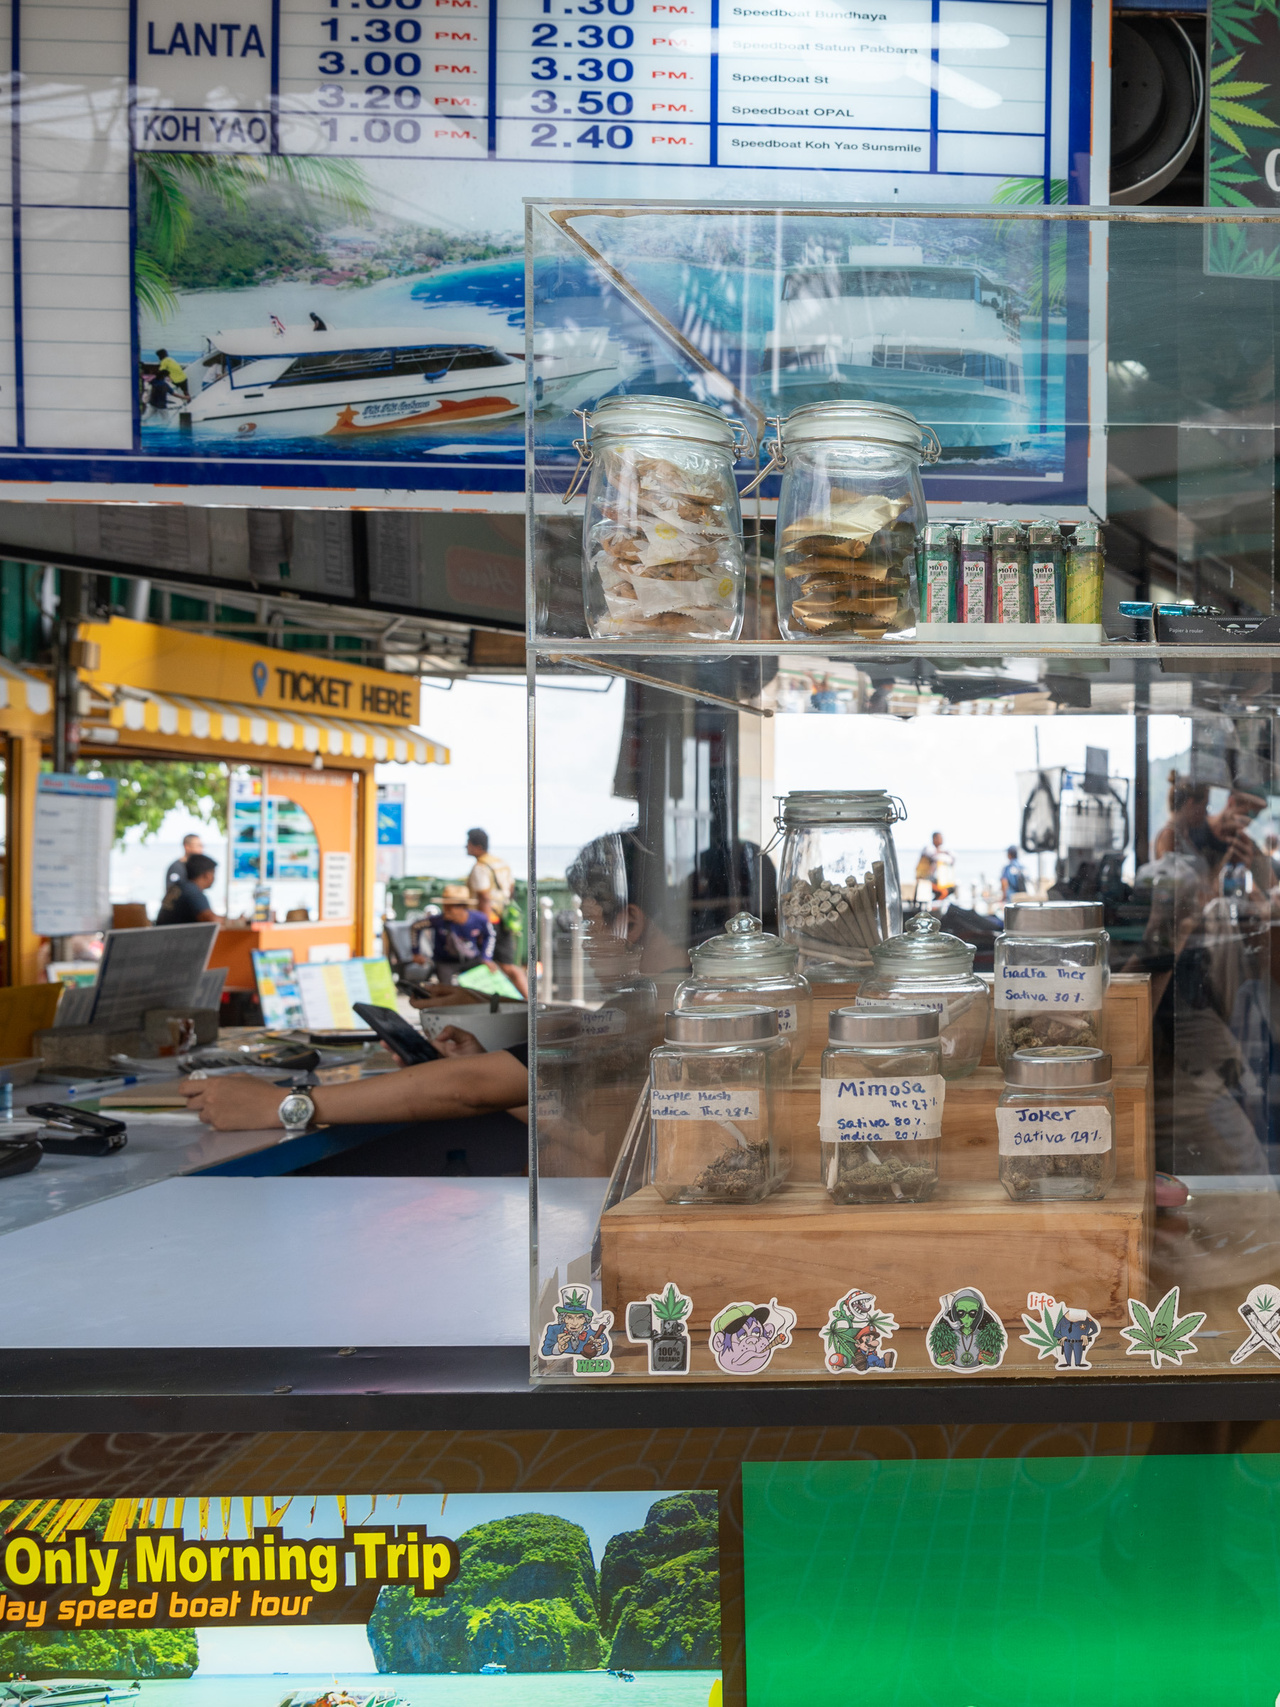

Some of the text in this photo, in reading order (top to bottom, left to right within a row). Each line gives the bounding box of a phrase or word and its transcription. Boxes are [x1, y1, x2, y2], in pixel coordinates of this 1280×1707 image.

[733, 8, 811, 19] Speedboat
[147, 22, 266, 59] LANTA
[320, 18, 478, 43] 1.30 PM.
[531, 23, 634, 49] 2.30
[733, 40, 918, 55] Speedboat Satun Pakbara
[318, 51, 478, 76] 3.00 PM.
[531, 57, 694, 82] 3.30 PM.
[732, 73, 829, 85] Speedboat St
[317, 84, 478, 110] 3.20 PM.
[531, 89, 694, 116] 3.50 PM.
[732, 105, 854, 118] Speedboat OPAL
[143, 115, 267, 144] KOH YAO
[320, 118, 477, 143] 1.00 PM.
[530, 123, 694, 149] 2.40 PM.
[732, 138, 922, 153] Speedboat Koh Yao Sunsmile
[275, 667, 412, 718] TICKET HERE
[1005, 989, 1048, 1001] Sativa
[1029, 1294, 1054, 1311] life
[658, 1347, 680, 1356] 100%
[576, 1359, 611, 1373] WEED
[5, 1531, 452, 1596] Only Morning Trip
[58, 1593, 157, 1629] speed
[169, 1591, 241, 1618] boat
[248, 1591, 313, 1618] tour
